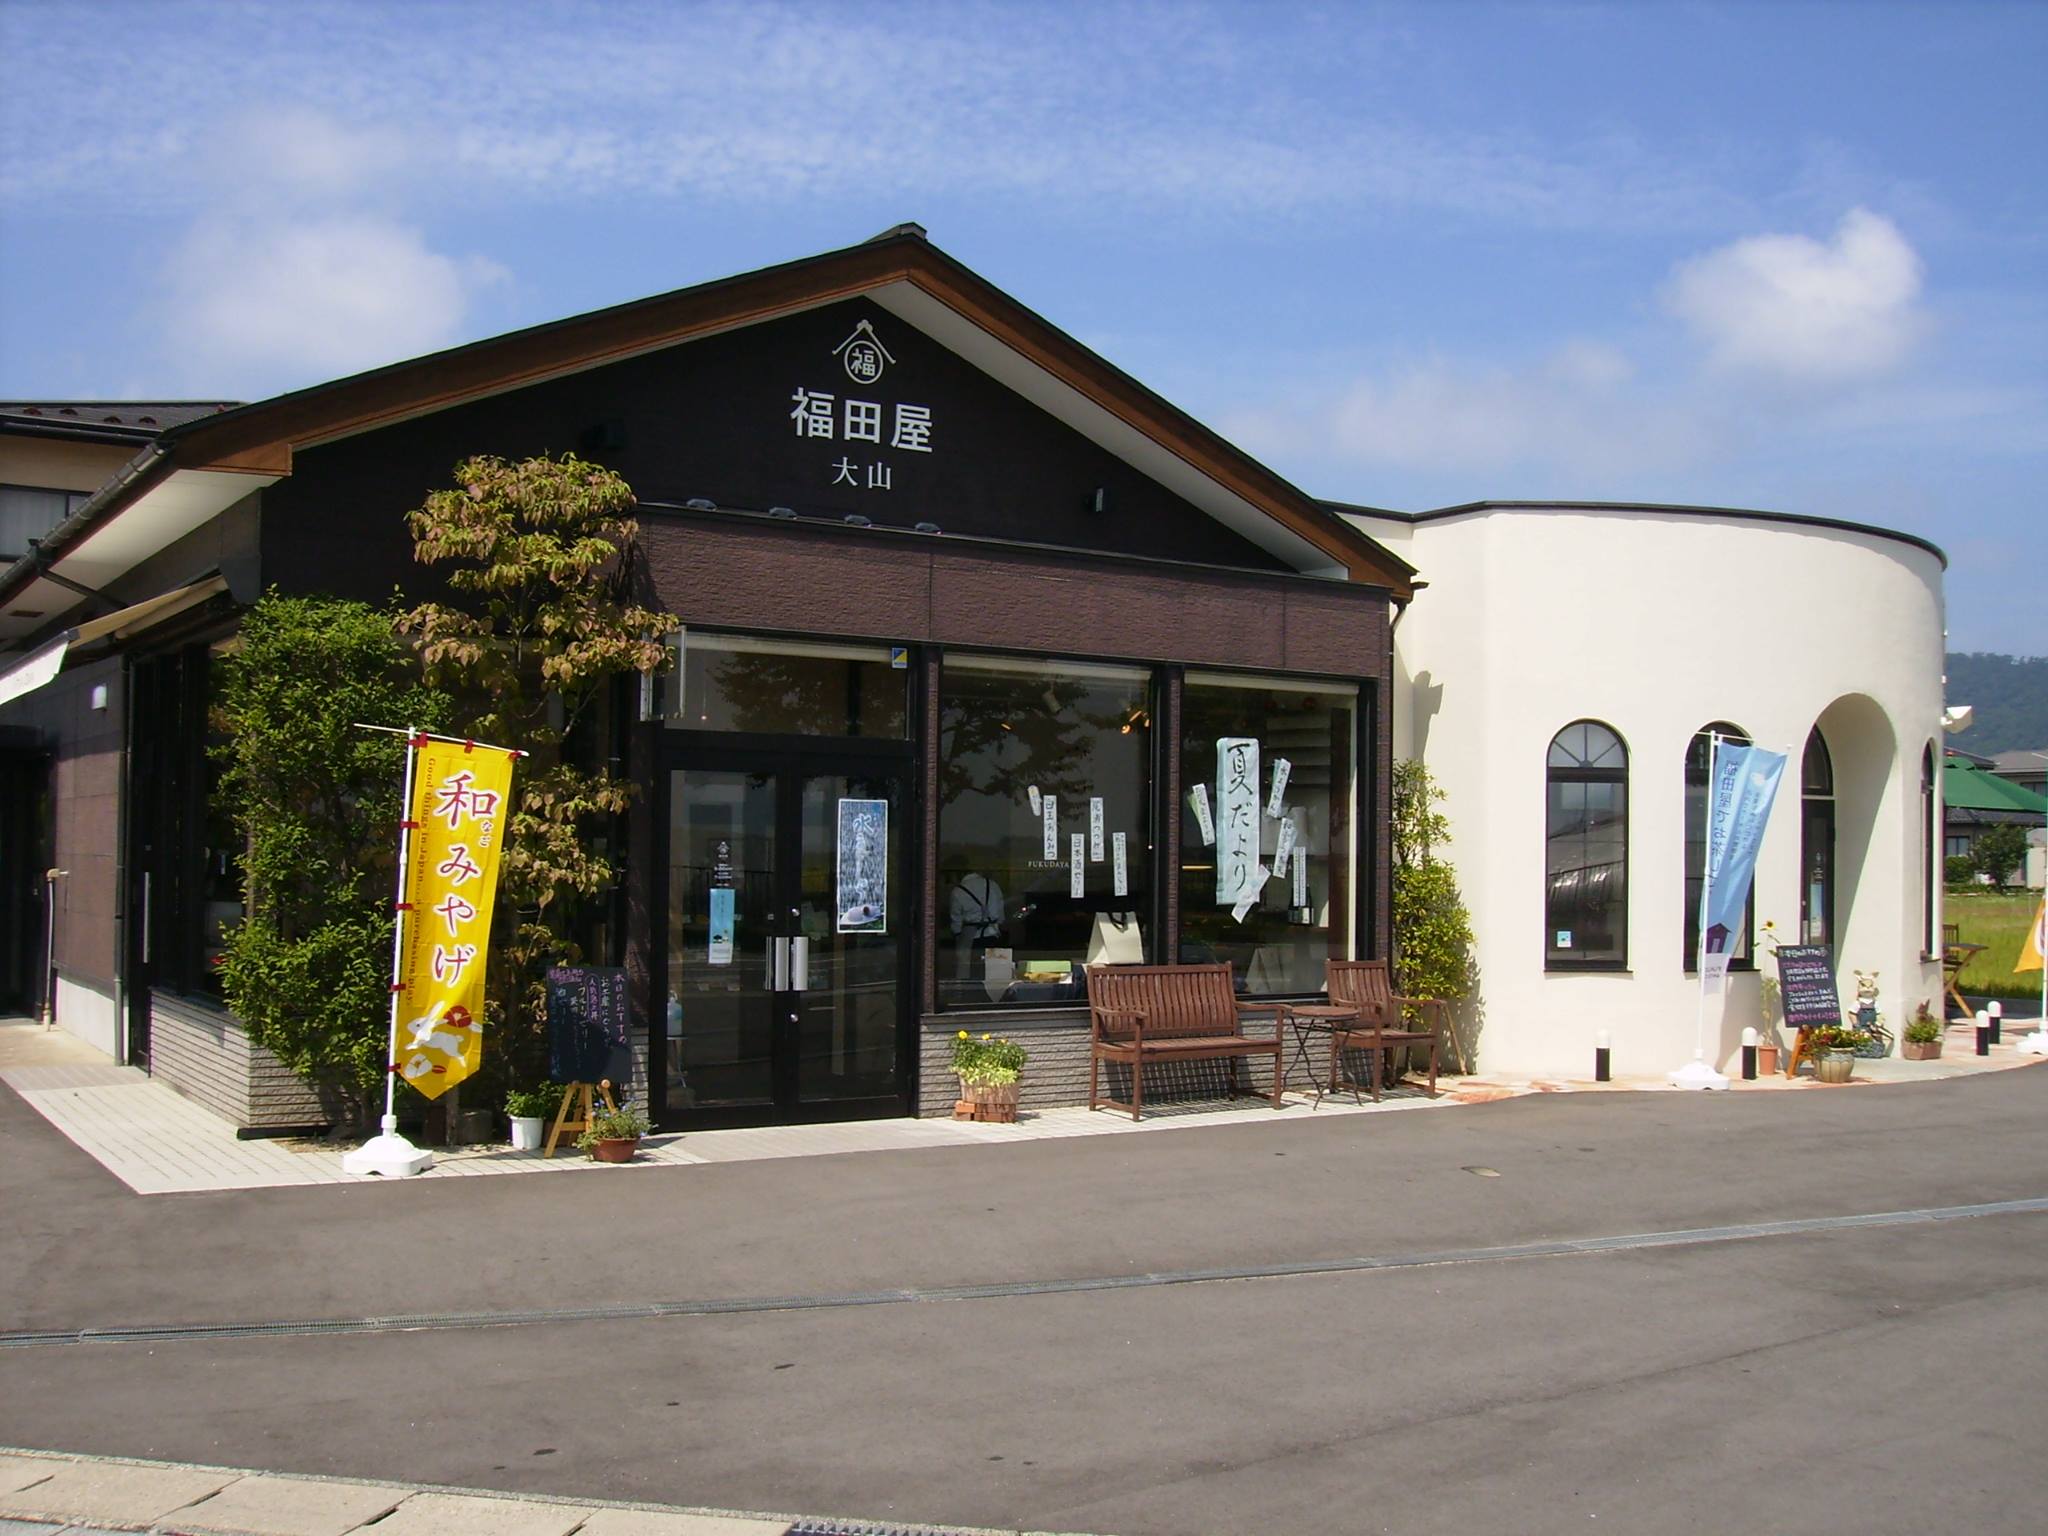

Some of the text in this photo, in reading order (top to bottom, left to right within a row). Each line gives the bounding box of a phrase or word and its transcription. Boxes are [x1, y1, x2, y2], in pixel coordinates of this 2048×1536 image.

[851, 348, 876, 377] 福
[790, 387, 933, 453] 福田屋
[832, 456, 892, 490] 大山
[425, 758, 436, 788] Good
[421, 792, 432, 829] things
[1045, 800, 1055, 858] 白玉あんみつ
[1227, 743, 1251, 892] 夏だより
[435, 772, 498, 985] 和みやげ
[1028, 861, 1069, 869] FUKUDAYA
